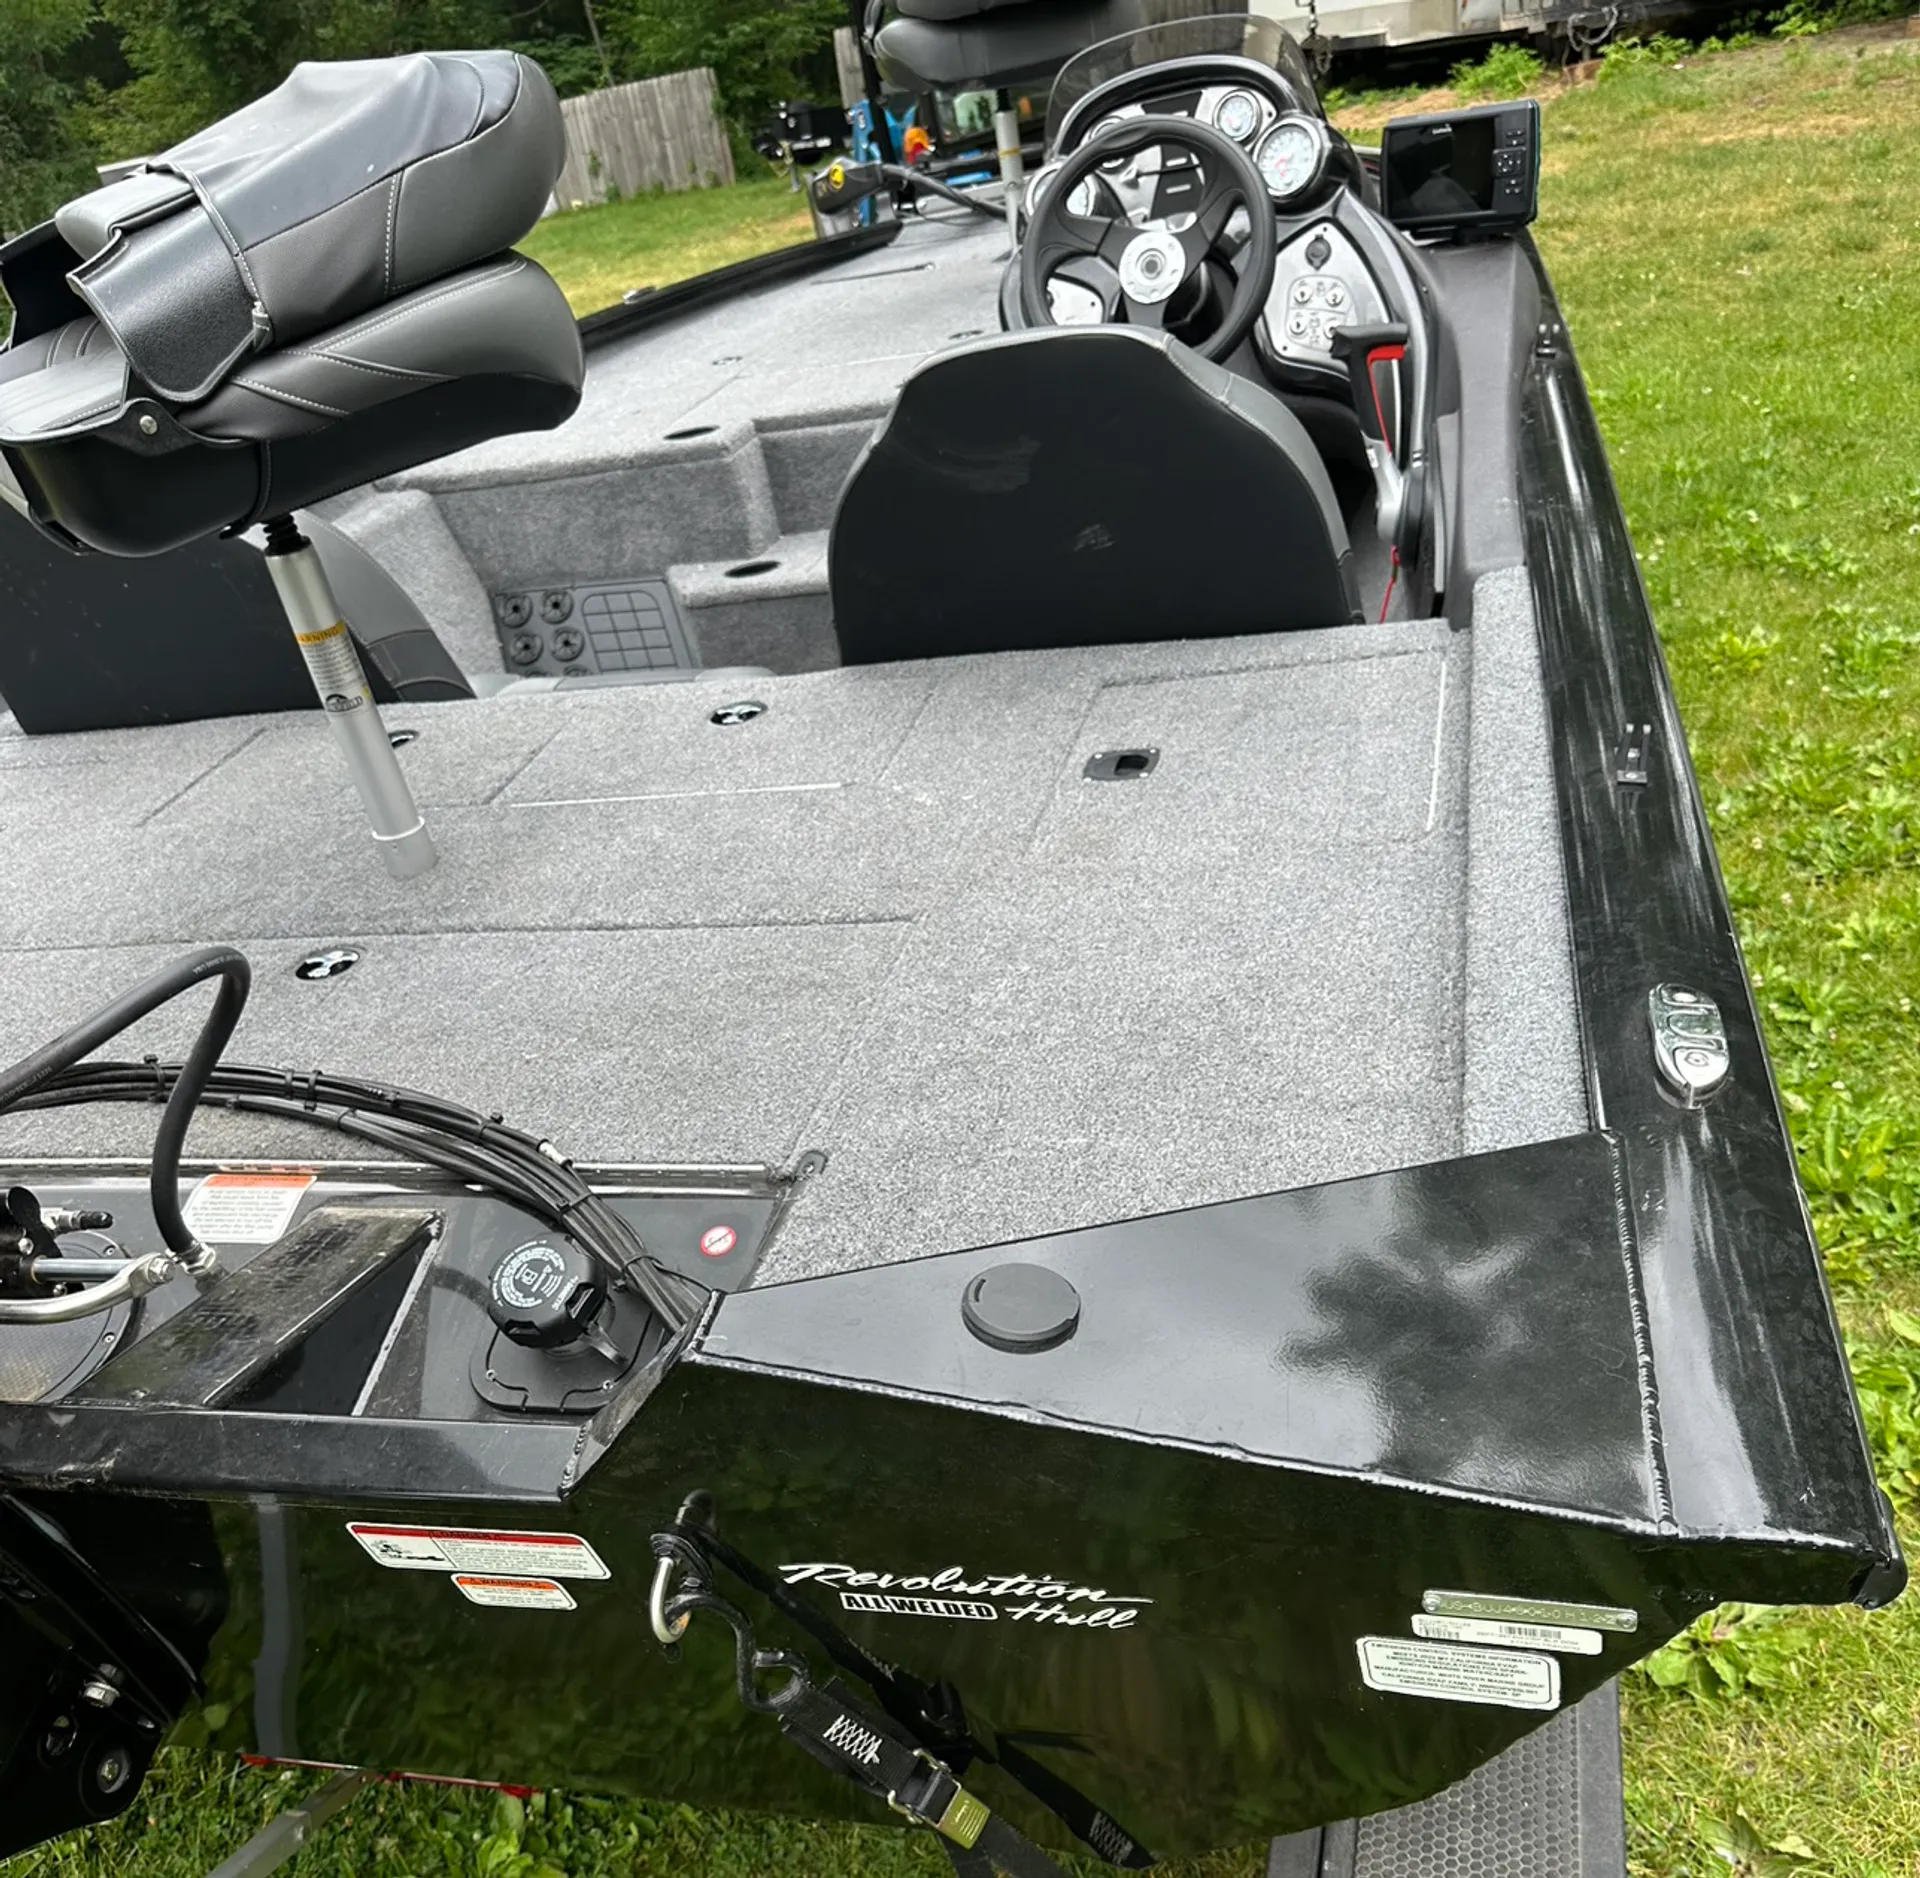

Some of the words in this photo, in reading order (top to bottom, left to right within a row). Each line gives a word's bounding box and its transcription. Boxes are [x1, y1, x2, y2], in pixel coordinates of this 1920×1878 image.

[778, 1563, 1153, 1604] Revolution
[845, 1595, 886, 1610] ALL
[889, 1597, 995, 1618] WELDED
[1005, 1601, 1139, 1629] Hull
